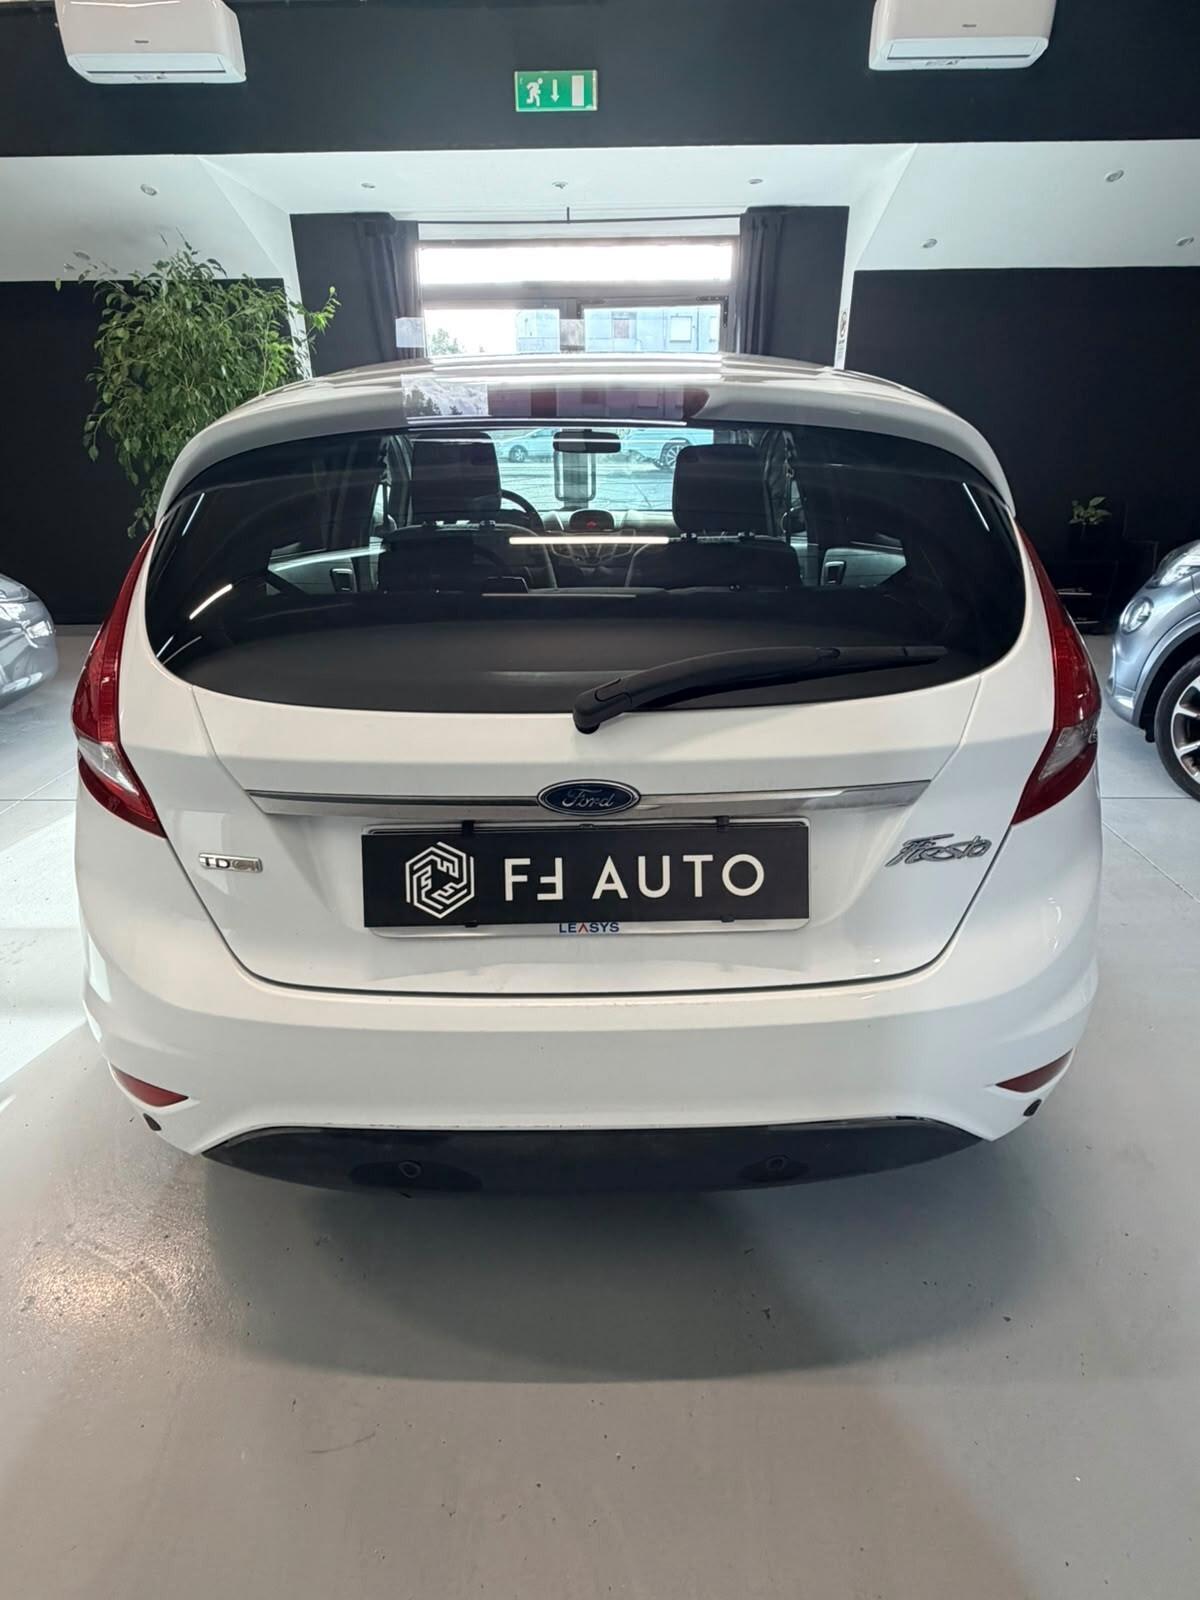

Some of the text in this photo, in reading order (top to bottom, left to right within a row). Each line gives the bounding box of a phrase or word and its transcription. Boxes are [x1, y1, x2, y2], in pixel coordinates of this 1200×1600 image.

[562, 788, 615, 807] Ford
[592, 854, 765, 898] AUTO
[559, 921, 620, 933] LEASYS
